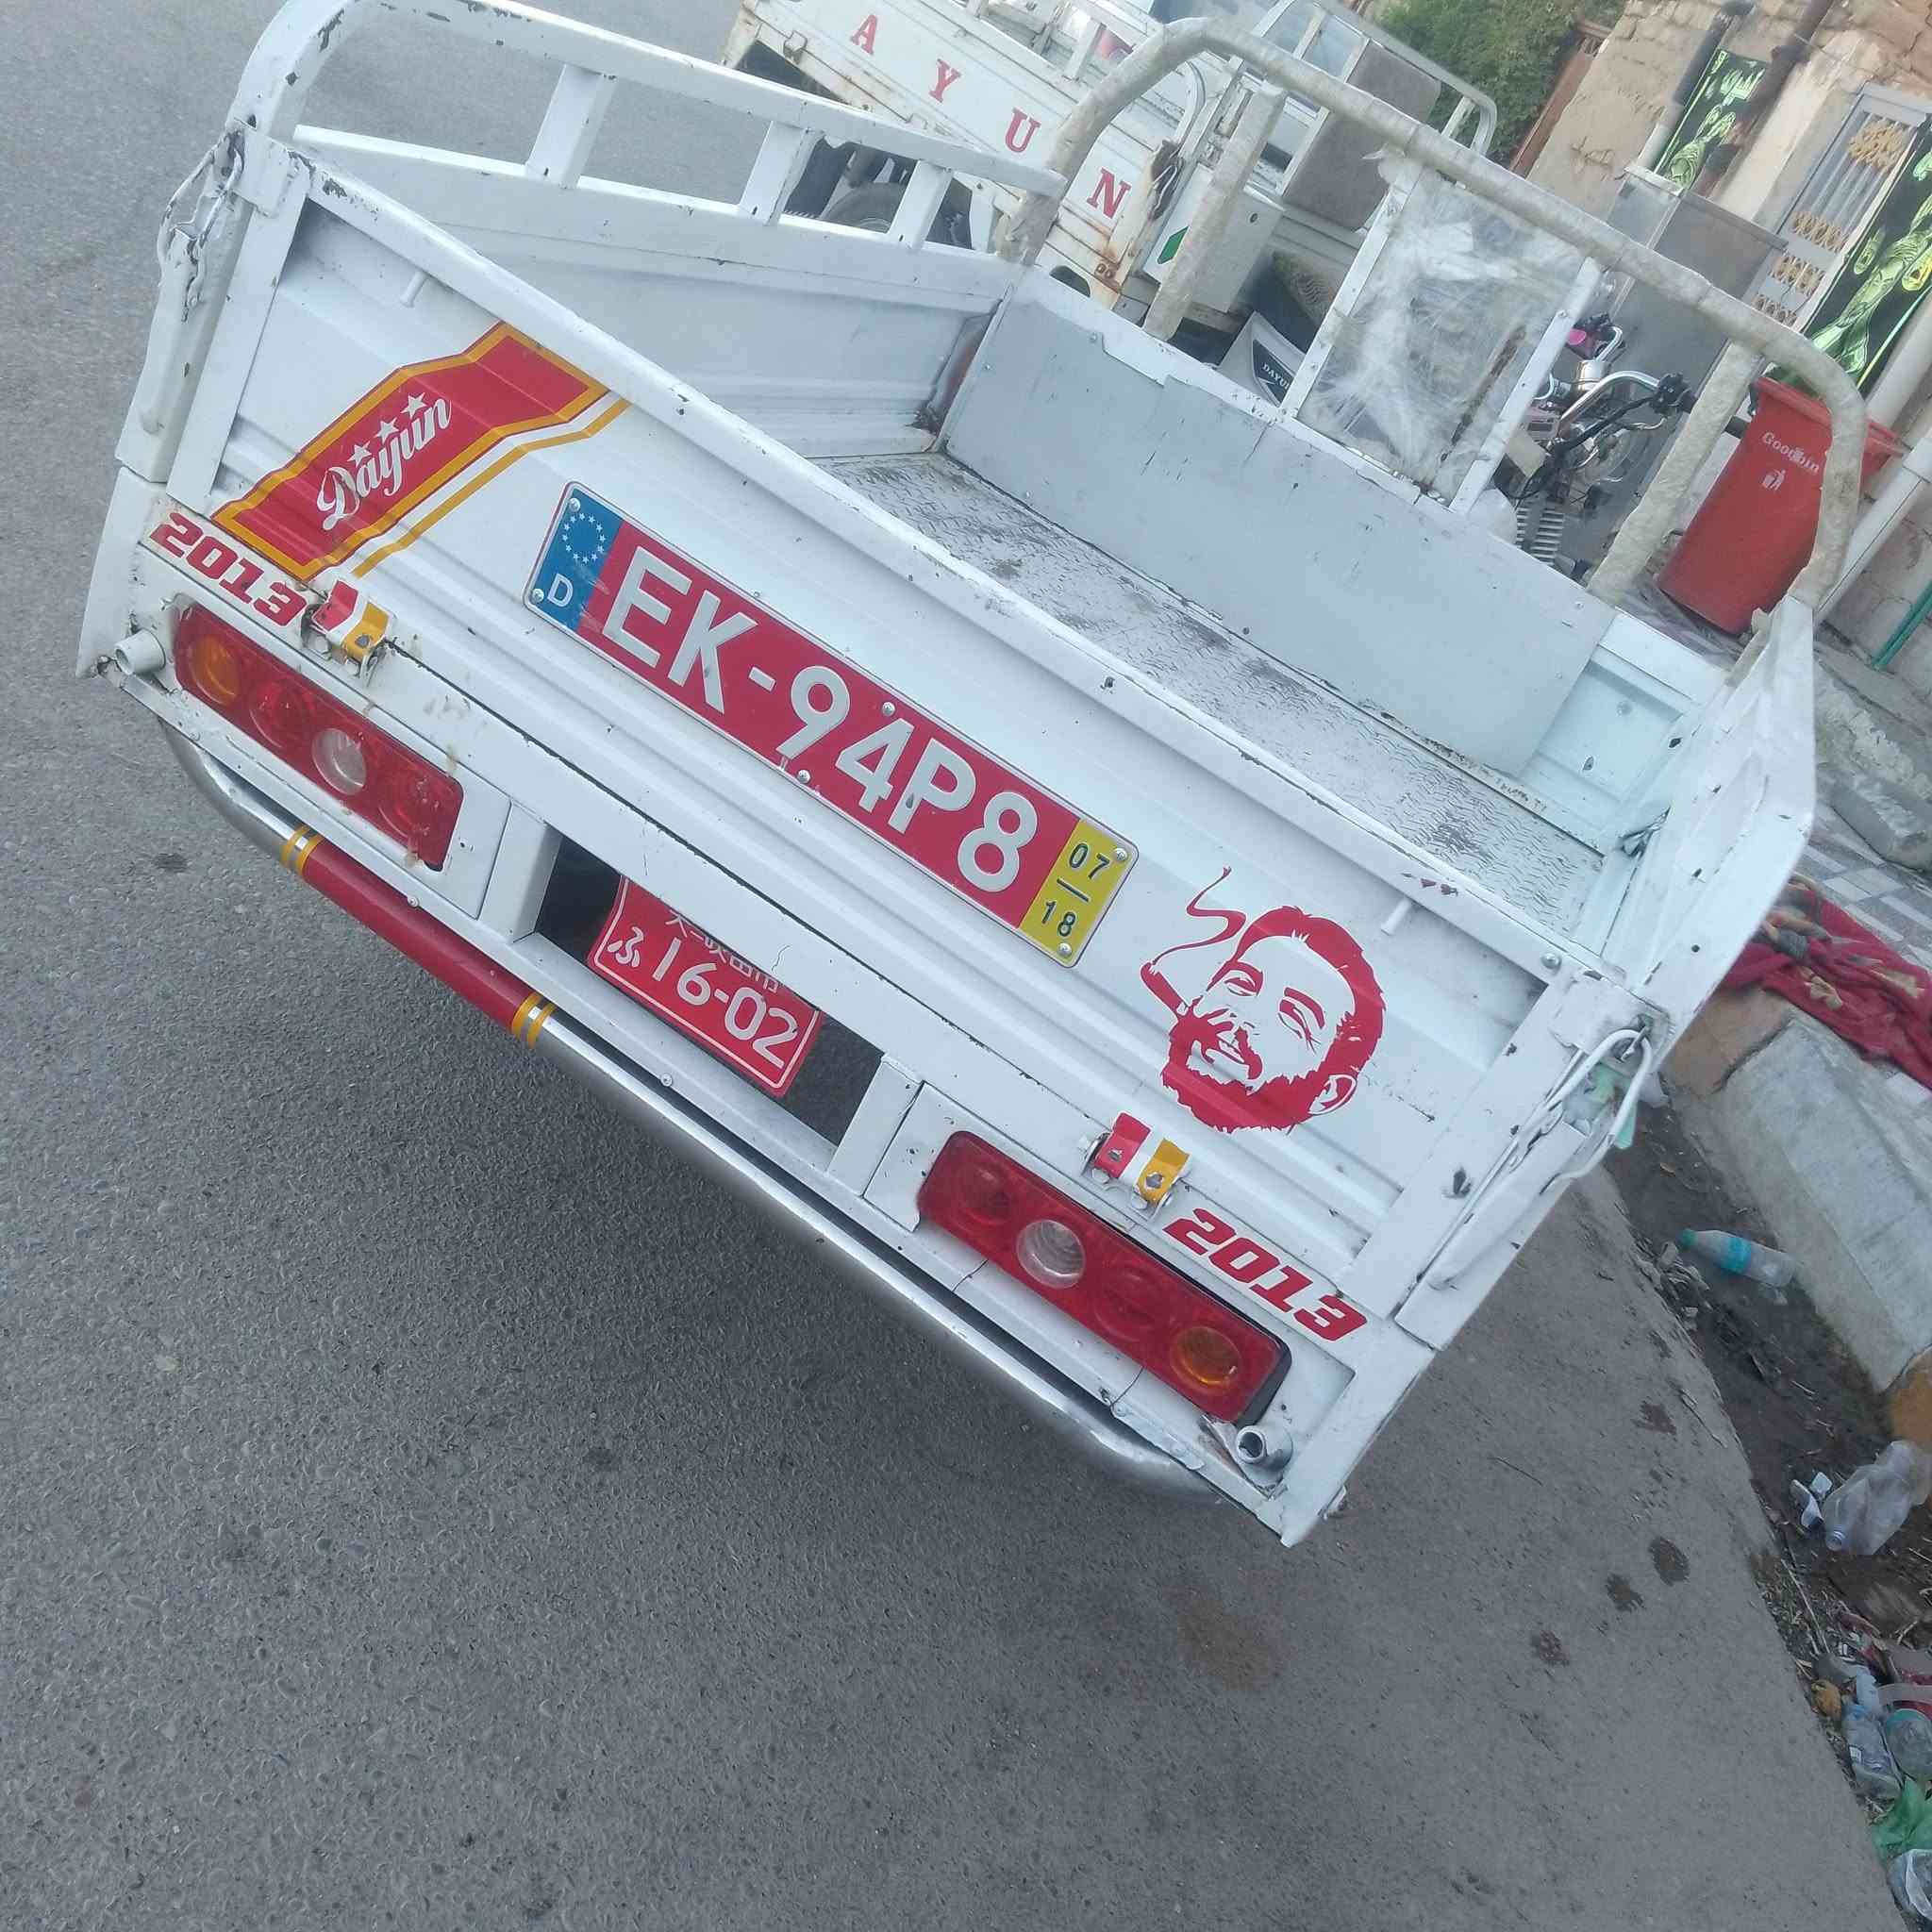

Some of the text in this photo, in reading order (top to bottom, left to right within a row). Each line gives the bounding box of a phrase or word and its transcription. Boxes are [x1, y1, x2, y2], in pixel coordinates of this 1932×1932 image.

[316, 399, 452, 530] Dayun
[150, 512, 307, 626] 2013
[547, 574, 573, 608] D
[601, 546, 1039, 892] EK-94P8
[1041, 899, 1078, 938] 18
[1070, 842, 1111, 879] 07
[651, 937, 799, 1070] 16-02
[1162, 1208, 1368, 1341] 2013
